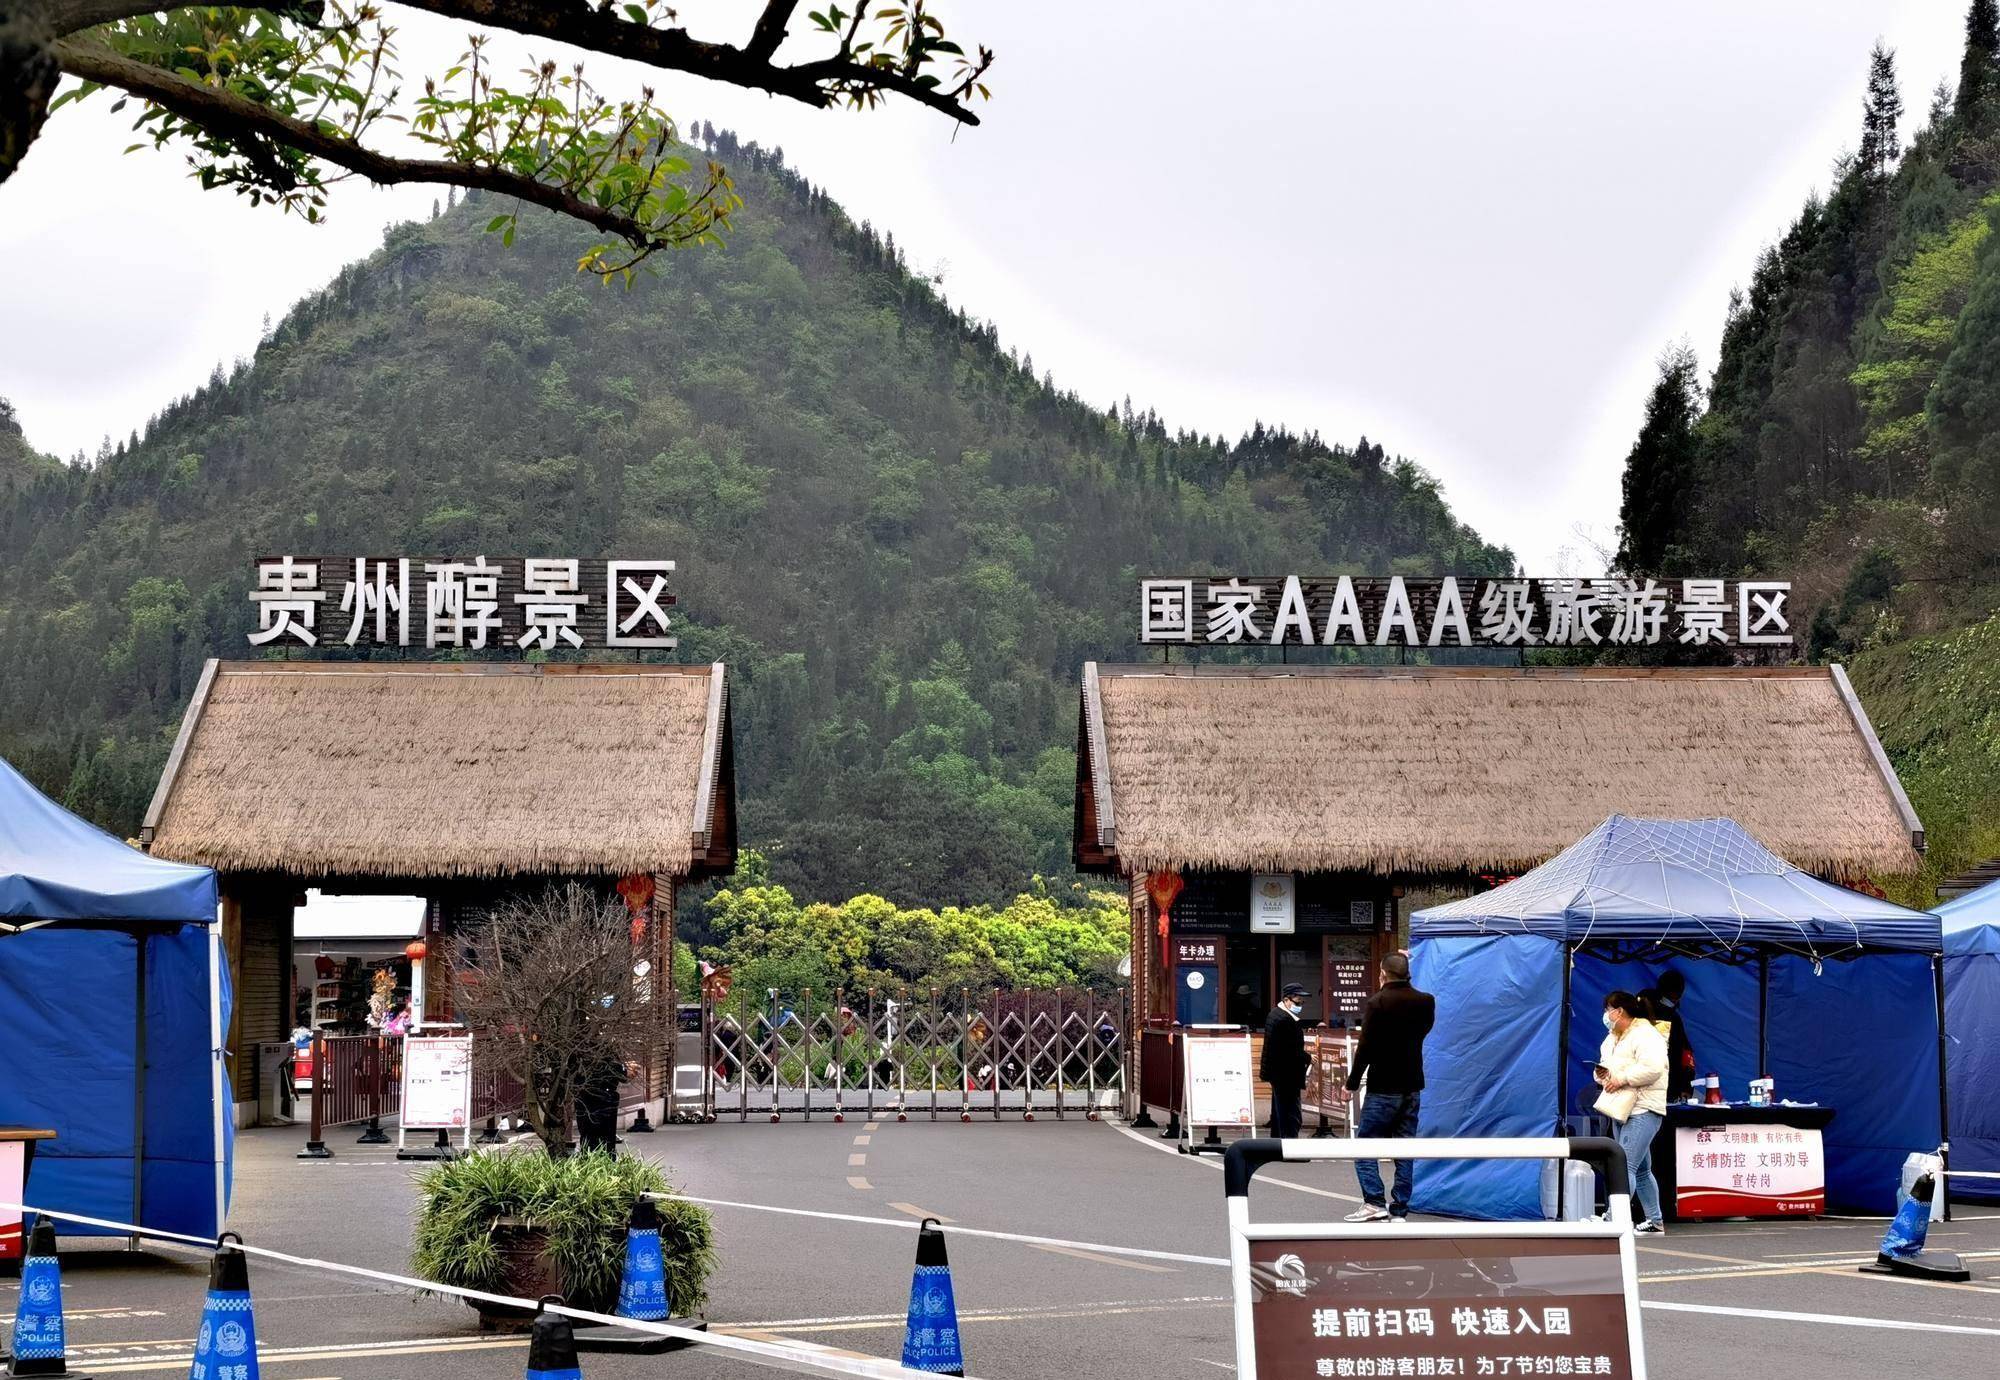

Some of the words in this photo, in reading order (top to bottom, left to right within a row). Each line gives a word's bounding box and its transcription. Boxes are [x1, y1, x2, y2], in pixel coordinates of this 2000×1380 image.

[247, 555, 678, 650] 贵州醇景区
[1141, 575, 1793, 647] 国家AAAA级旅游景区
[1179, 945, 1215, 957] 年卡办理
[1722, 1132, 1759, 1144] 文明健康
[1766, 1132, 1805, 1143] 有你有我
[1692, 1152, 1746, 1168] 疫情防控
[1757, 1151, 1809, 1168] 文明劝导
[1732, 1173, 1771, 1189] 宣传岗
[634, 1280, 666, 1295] 警察
[633, 1296, 666, 1304] POLICE
[24, 1314, 61, 1331] 警察
[1312, 1308, 1435, 1338] 提前扫码
[1451, 1306, 1572, 1336] 快速入园
[21, 1333, 61, 1342] POLICE
[921, 1328, 955, 1346] 警察
[920, 1347, 956, 1356] POLICE
[218, 1364, 248, 1380] 警察
[1316, 1355, 1612, 1377] 尊敬的游客朋友！为了节约您宝贵
